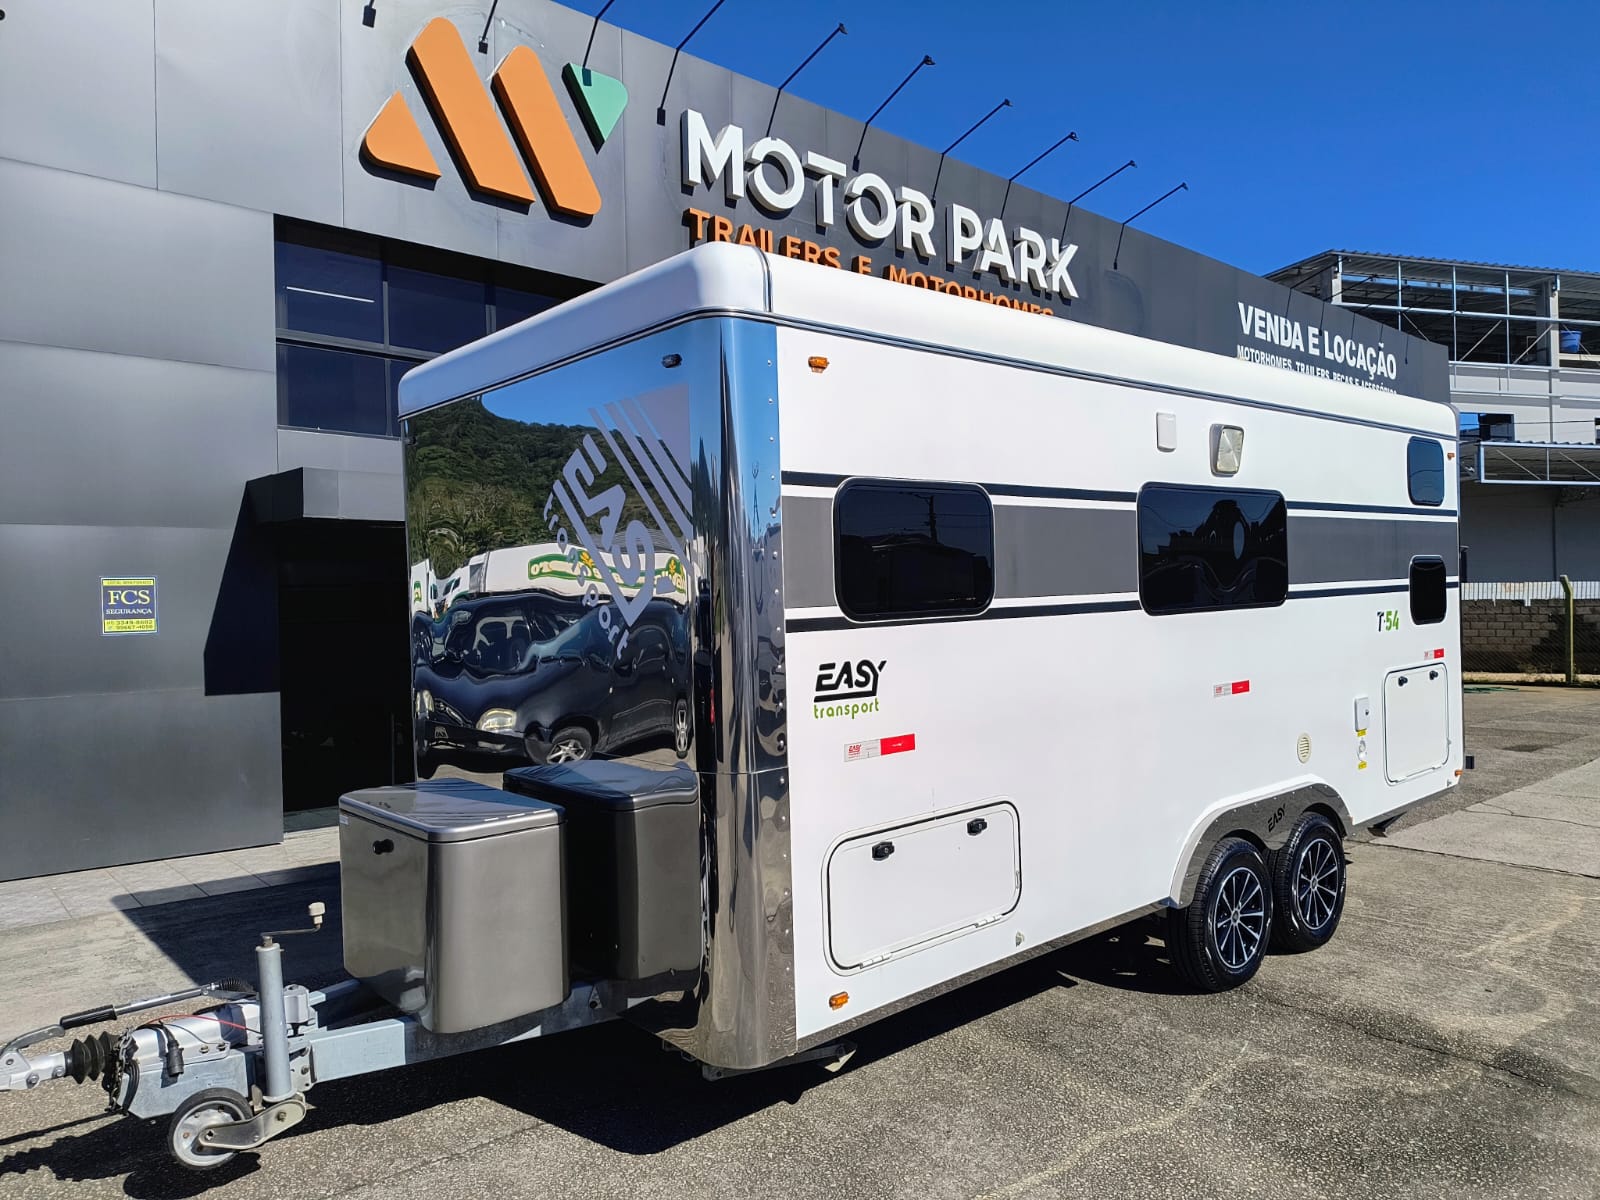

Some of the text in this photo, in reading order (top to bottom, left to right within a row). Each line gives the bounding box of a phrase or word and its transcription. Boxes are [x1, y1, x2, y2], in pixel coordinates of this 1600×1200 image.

[682, 108, 1079, 298] MOTOR PARK
[689, 207, 841, 270] TRAILERS
[857, 255, 872, 275] E
[1237, 301, 1398, 380] VENDA E LOCAÇÃO
[107, 589, 151, 605] FCS
[814, 659, 887, 702] EASY
[813, 697, 880, 719] transport
[1267, 802, 1286, 832] EASY
